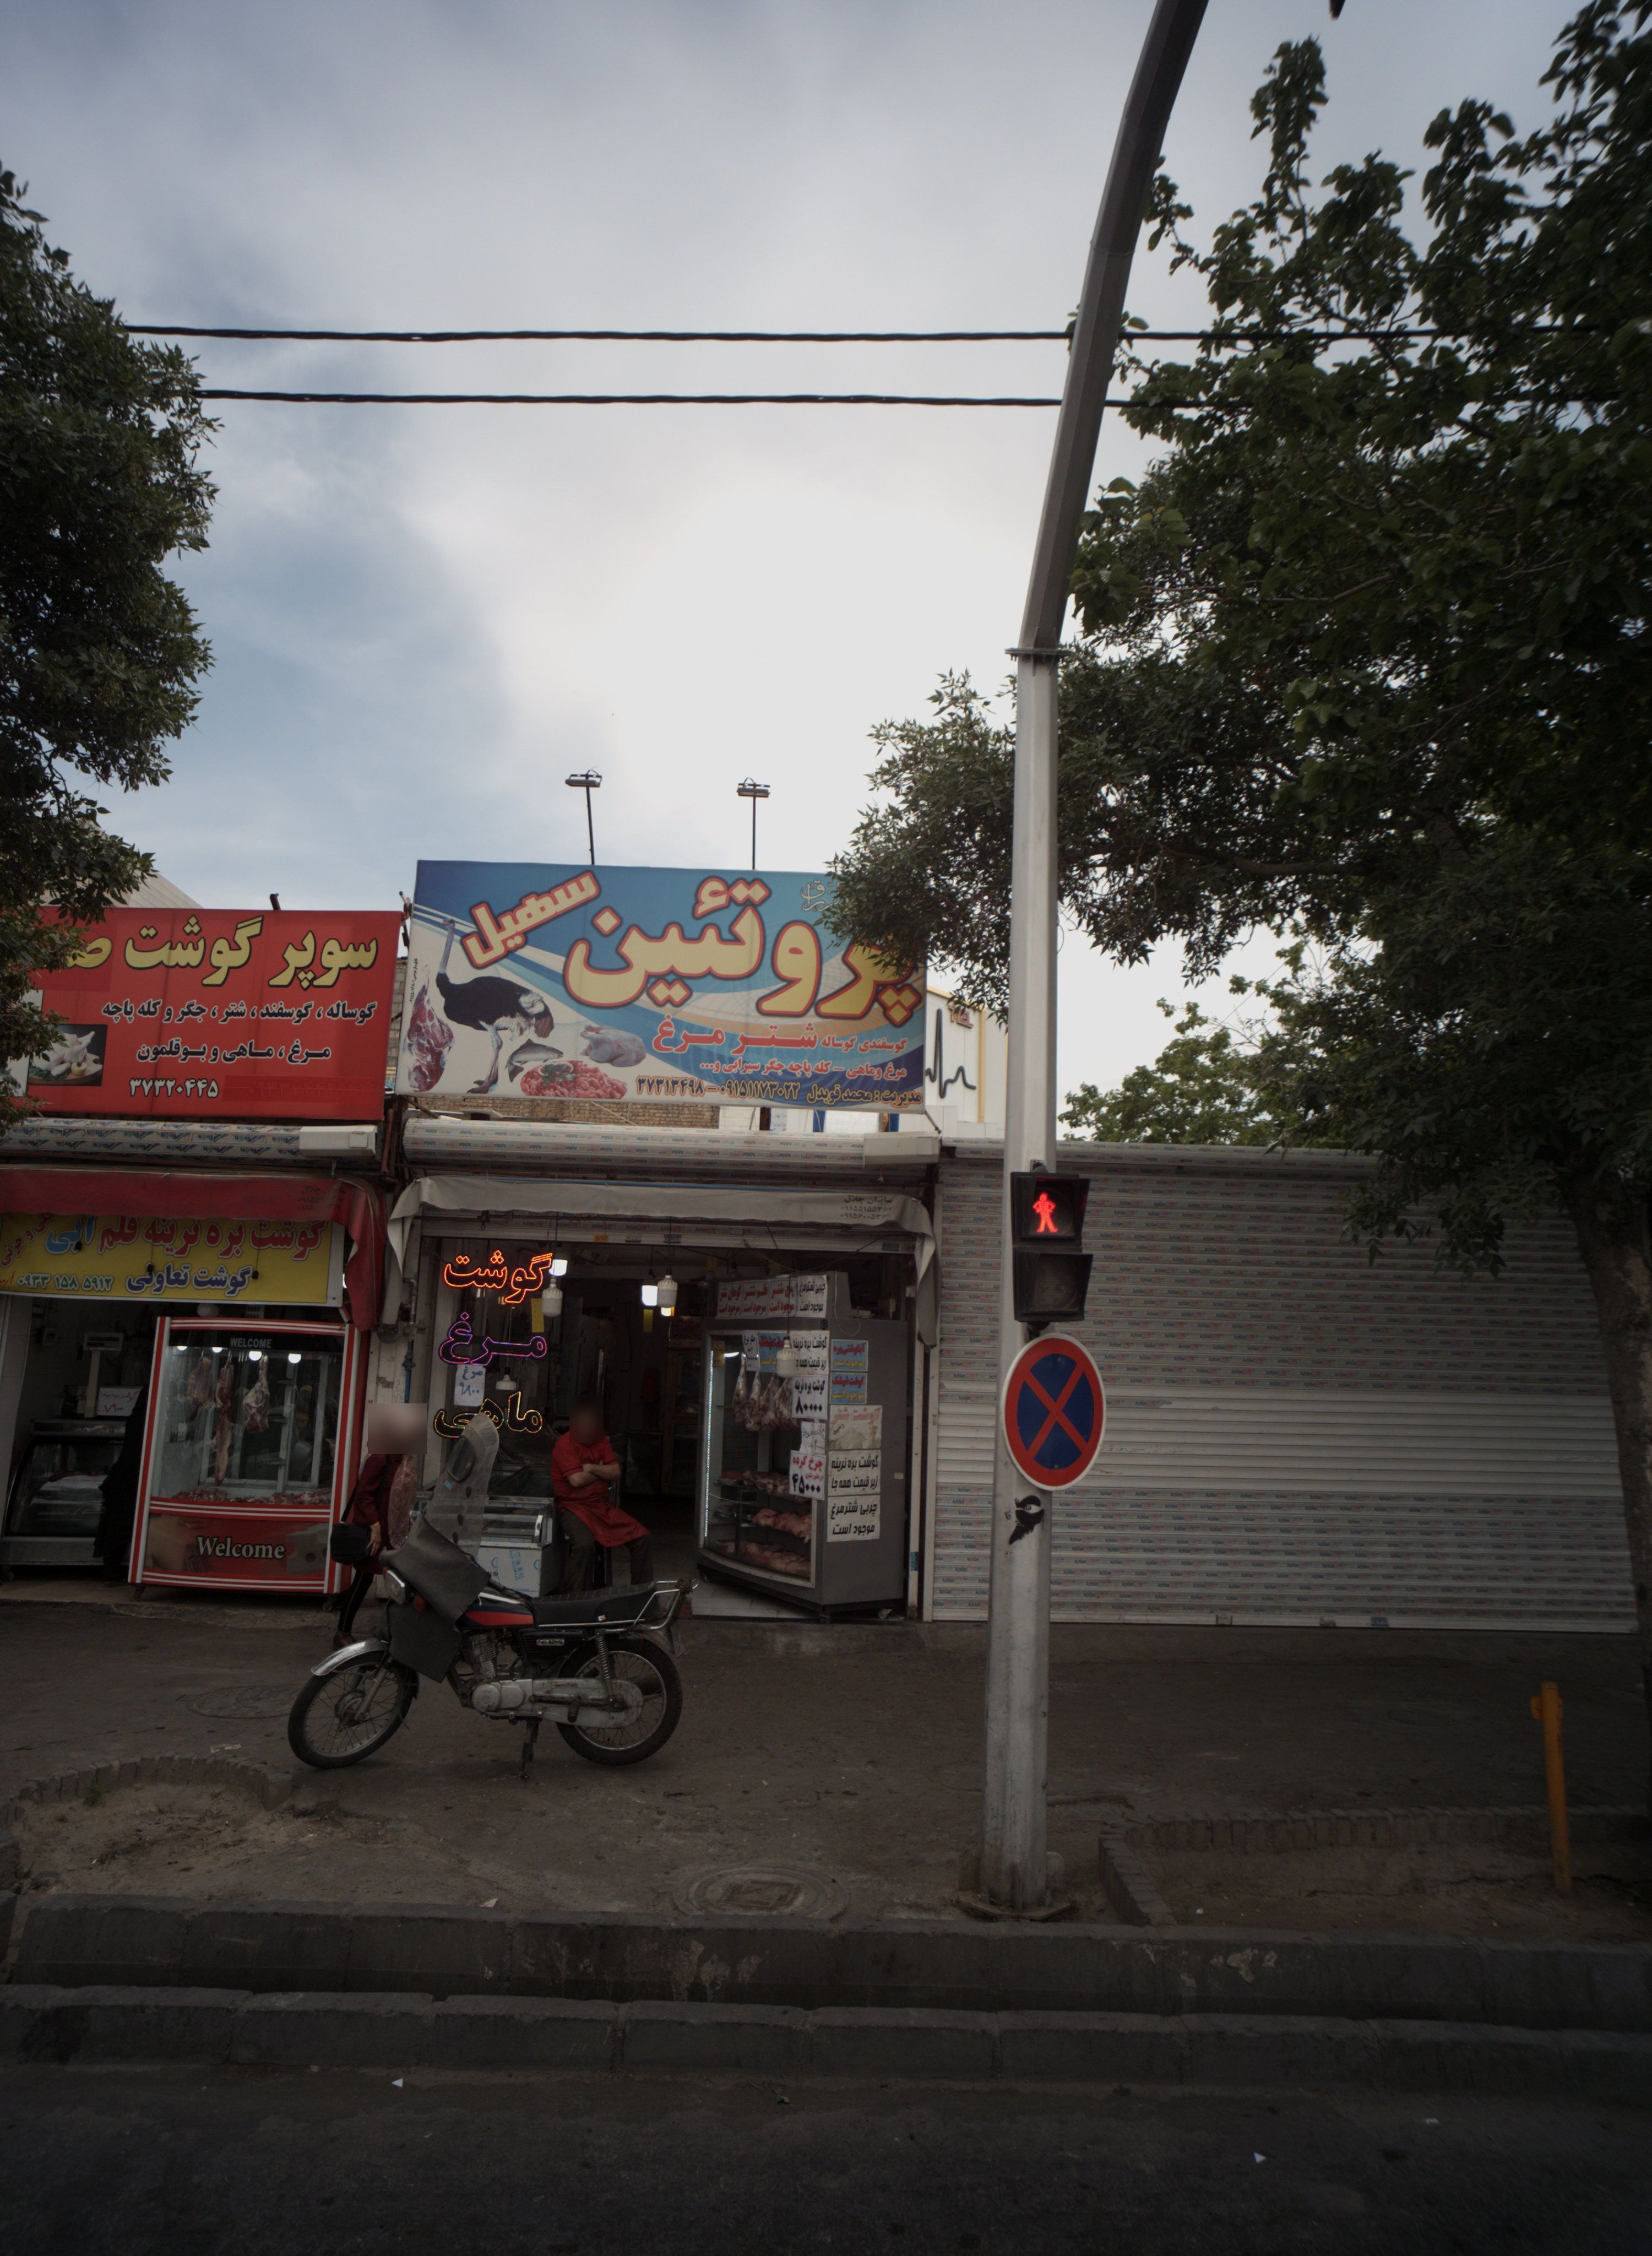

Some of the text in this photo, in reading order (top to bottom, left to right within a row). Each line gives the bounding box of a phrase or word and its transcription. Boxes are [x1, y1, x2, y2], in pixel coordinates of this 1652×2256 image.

[124, 915, 264, 987] گوشت
[460, 869, 922, 1027] پروتئین سهیل
[268, 930, 378, 990] سوپر
[101, 998, 377, 1024] گوساله گوسفند شتر جگر و کله پاچه
[137, 1038, 332, 1064] مرغ ماهی و بوقلمون
[722, 1058, 760, 1074] سیرابی
[762, 1061, 785, 1075] جگر
[788, 1060, 812, 1077] پاچه
[813, 1061, 832, 1074] کله
[883, 1062, 907, 1080] مرغ
[129, 1077, 219, 1098] ۳۷۳۲۰۴۴۵
[842, 1088, 873, 1102] محمد
[204, 1220, 246, 1258] بره
[249, 1219, 328, 1261] گوشت
[17, 1273, 51, 1289] ۰۹۳۳
[55, 1274, 79, 1289] ۱۵۸
[126, 1262, 252, 1297] گوشت تعاونی
[443, 1249, 553, 1304] گوشت
[230, 1337, 272, 1349] WELCOME
[438, 1311, 547, 1366] مرغ
[433, 1391, 544, 1438] ماهی
[832, 1454, 878, 1472] گوشت بره نرینه
[839, 1479, 851, 1488] همه
[854, 1476, 869, 1490] قیمت
[860, 1504, 877, 1517] چربی
[833, 1523, 875, 1536] موجود است
[196, 1536, 286, 1559] Welcome
